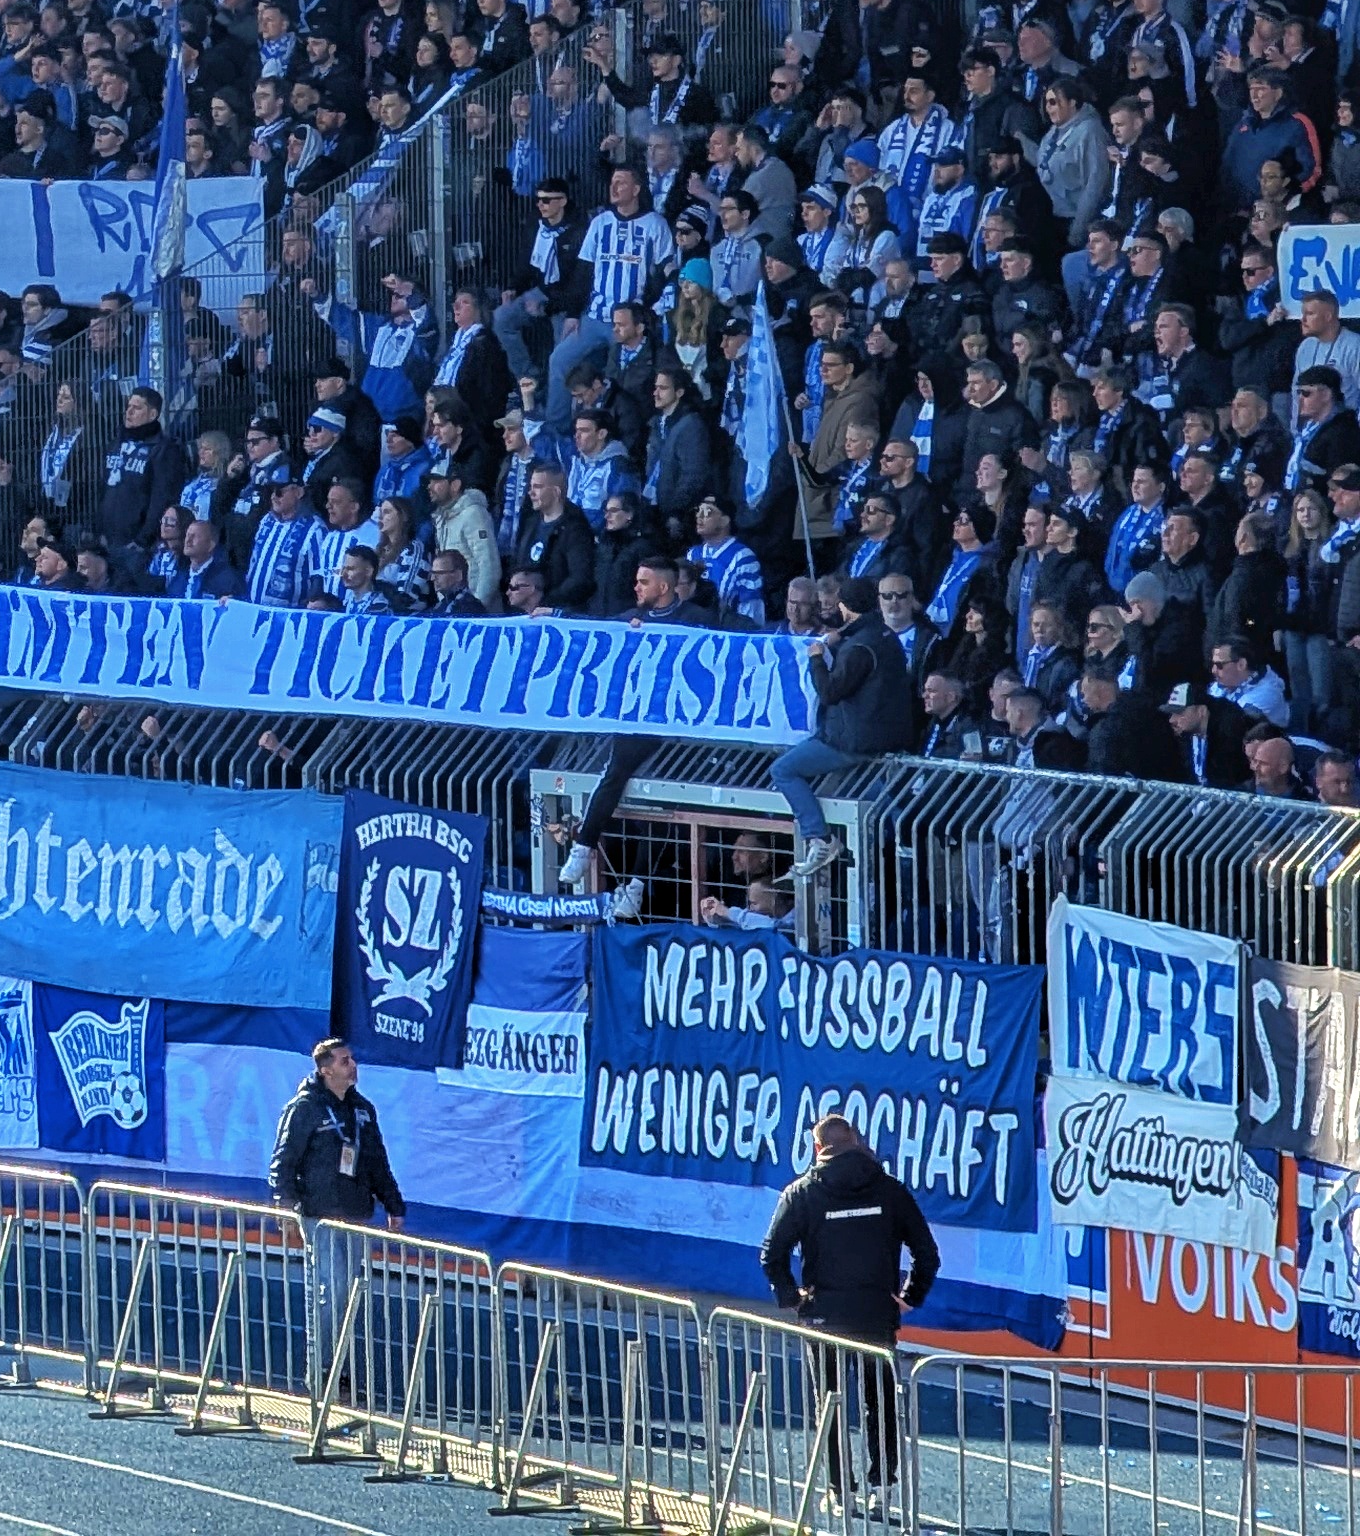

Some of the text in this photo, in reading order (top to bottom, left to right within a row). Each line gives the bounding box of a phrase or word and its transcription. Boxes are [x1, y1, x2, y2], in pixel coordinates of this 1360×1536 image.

[249, 608, 821, 733] TICKETPREISEN
[356, 812, 474, 864] HERTHA BSC
[382, 864, 443, 950] SZ
[518, 895, 553, 917] CREW
[554, 897, 600, 916] NORTH
[62, 1024, 129, 1069] BERLINER
[643, 942, 989, 1068] MEHR FUSSBALL
[80, 1088, 111, 1113] KIND
[1249, 978, 1360, 1144] STA
[590, 1066, 780, 1165] WENIGER
[1051, 1094, 1236, 1205] Hattingen
